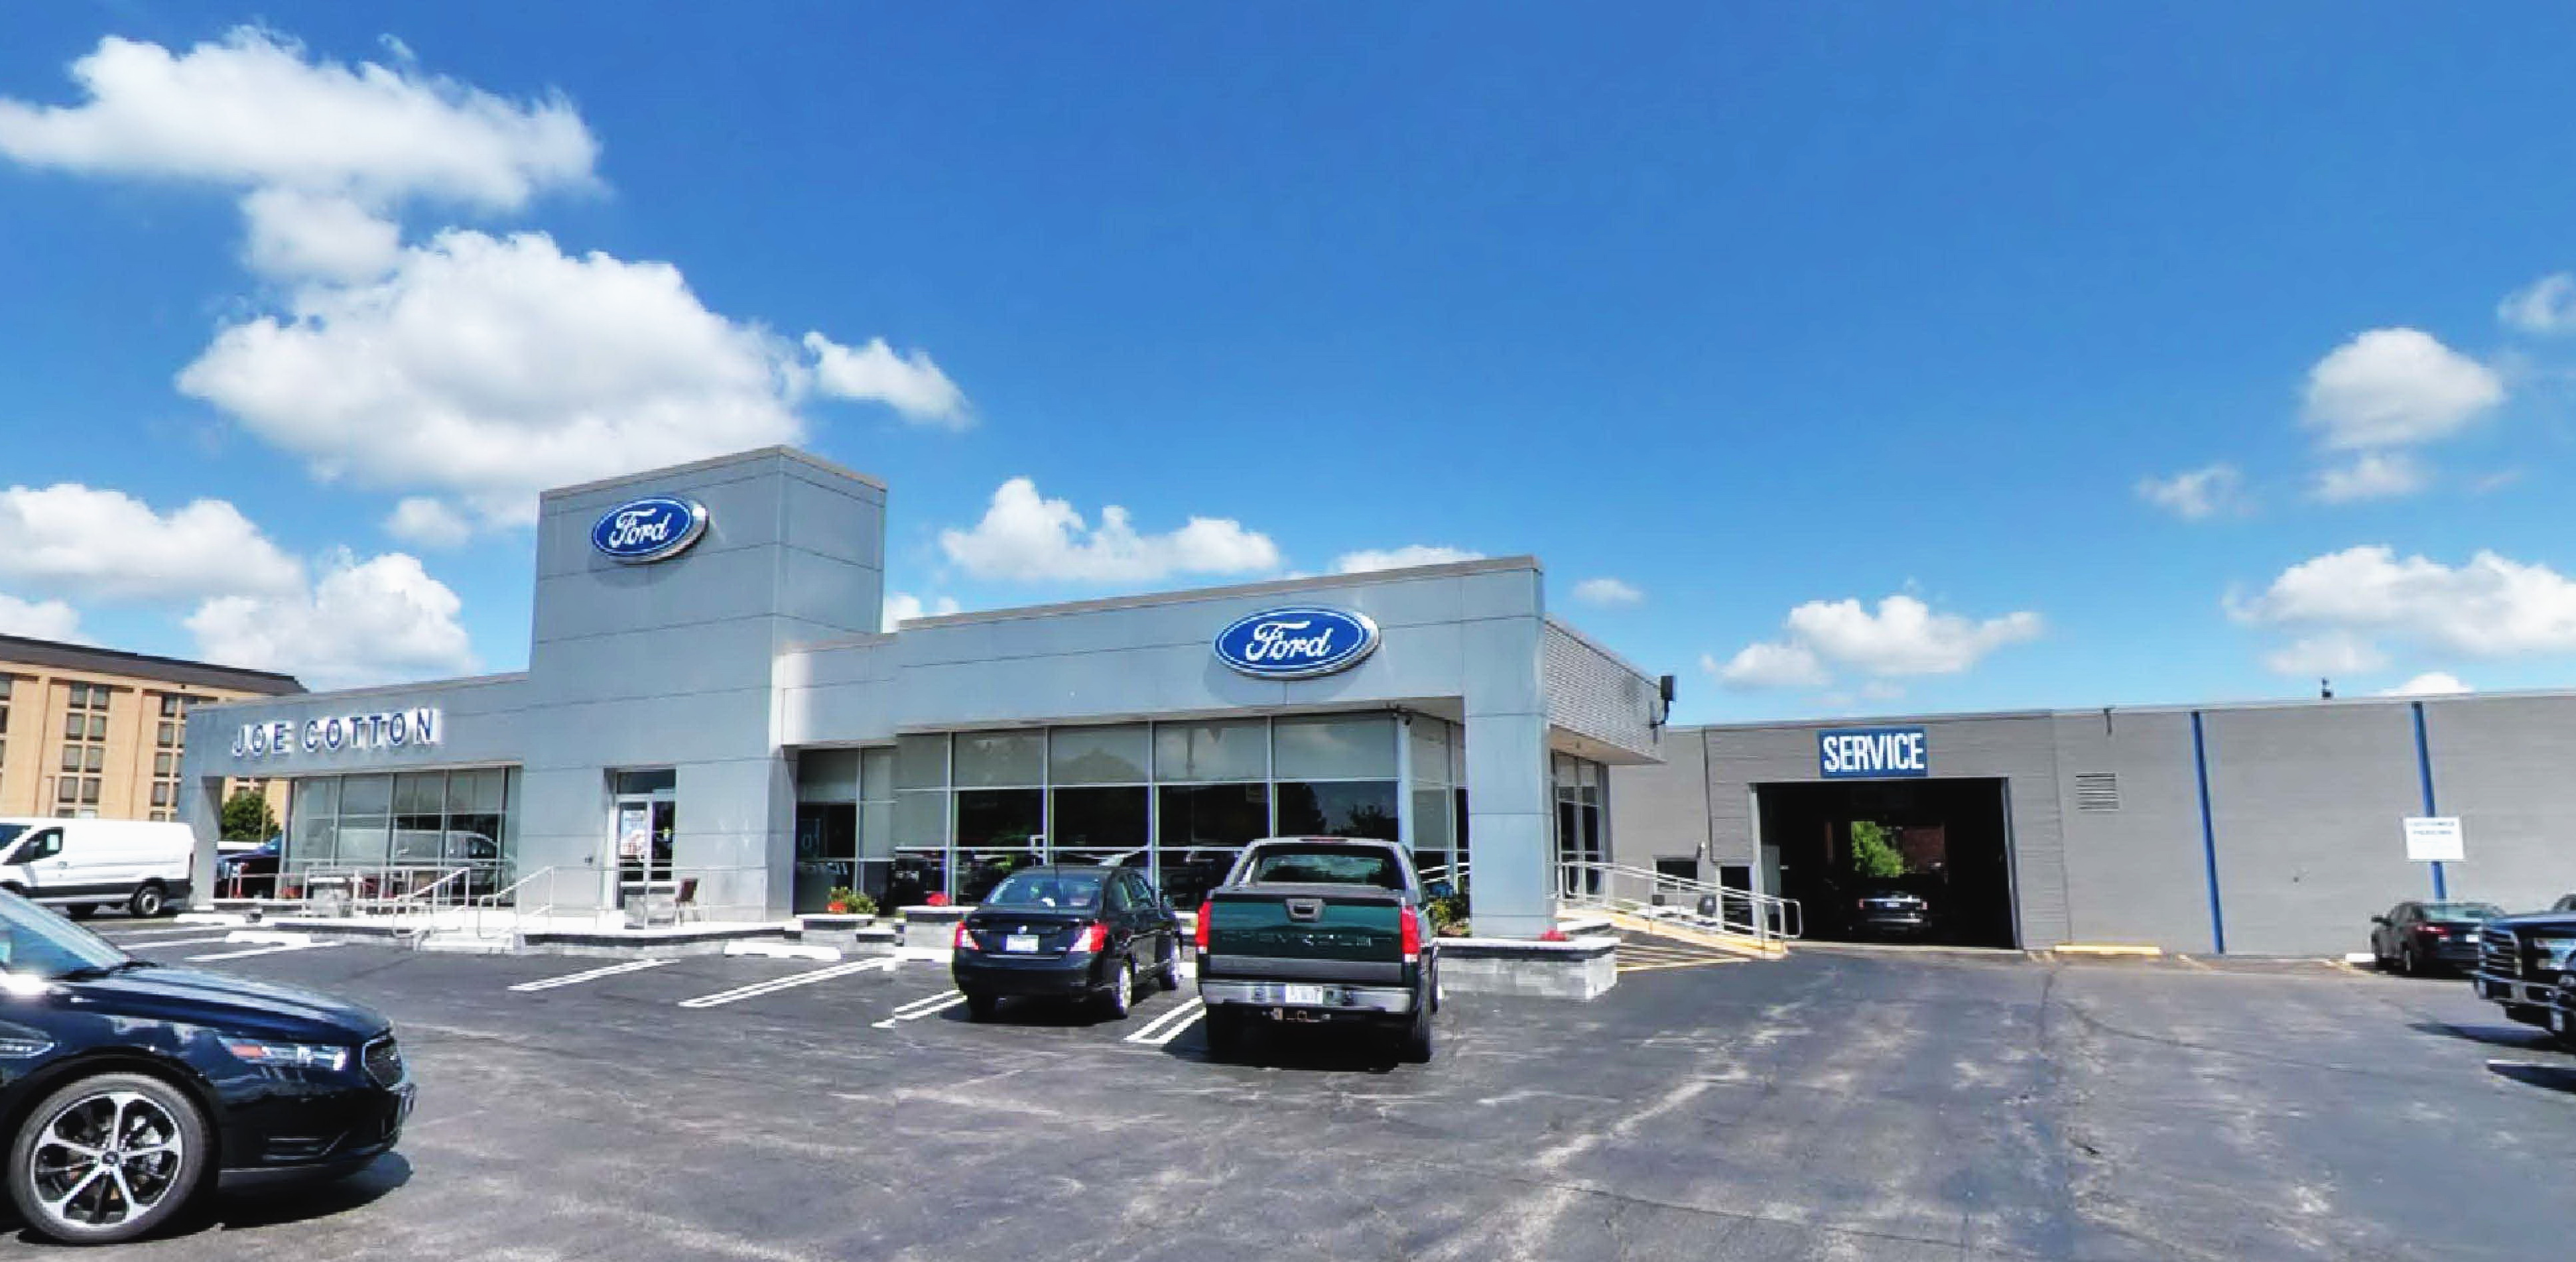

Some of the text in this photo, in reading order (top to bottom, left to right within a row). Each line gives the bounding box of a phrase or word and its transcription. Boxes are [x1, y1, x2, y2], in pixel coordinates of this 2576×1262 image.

[608, 508, 672, 548] Ford
[1245, 621, 1334, 662] Ford
[232, 707, 440, 757] JOE COTTON
[1823, 732, 1925, 772] SERVICE
